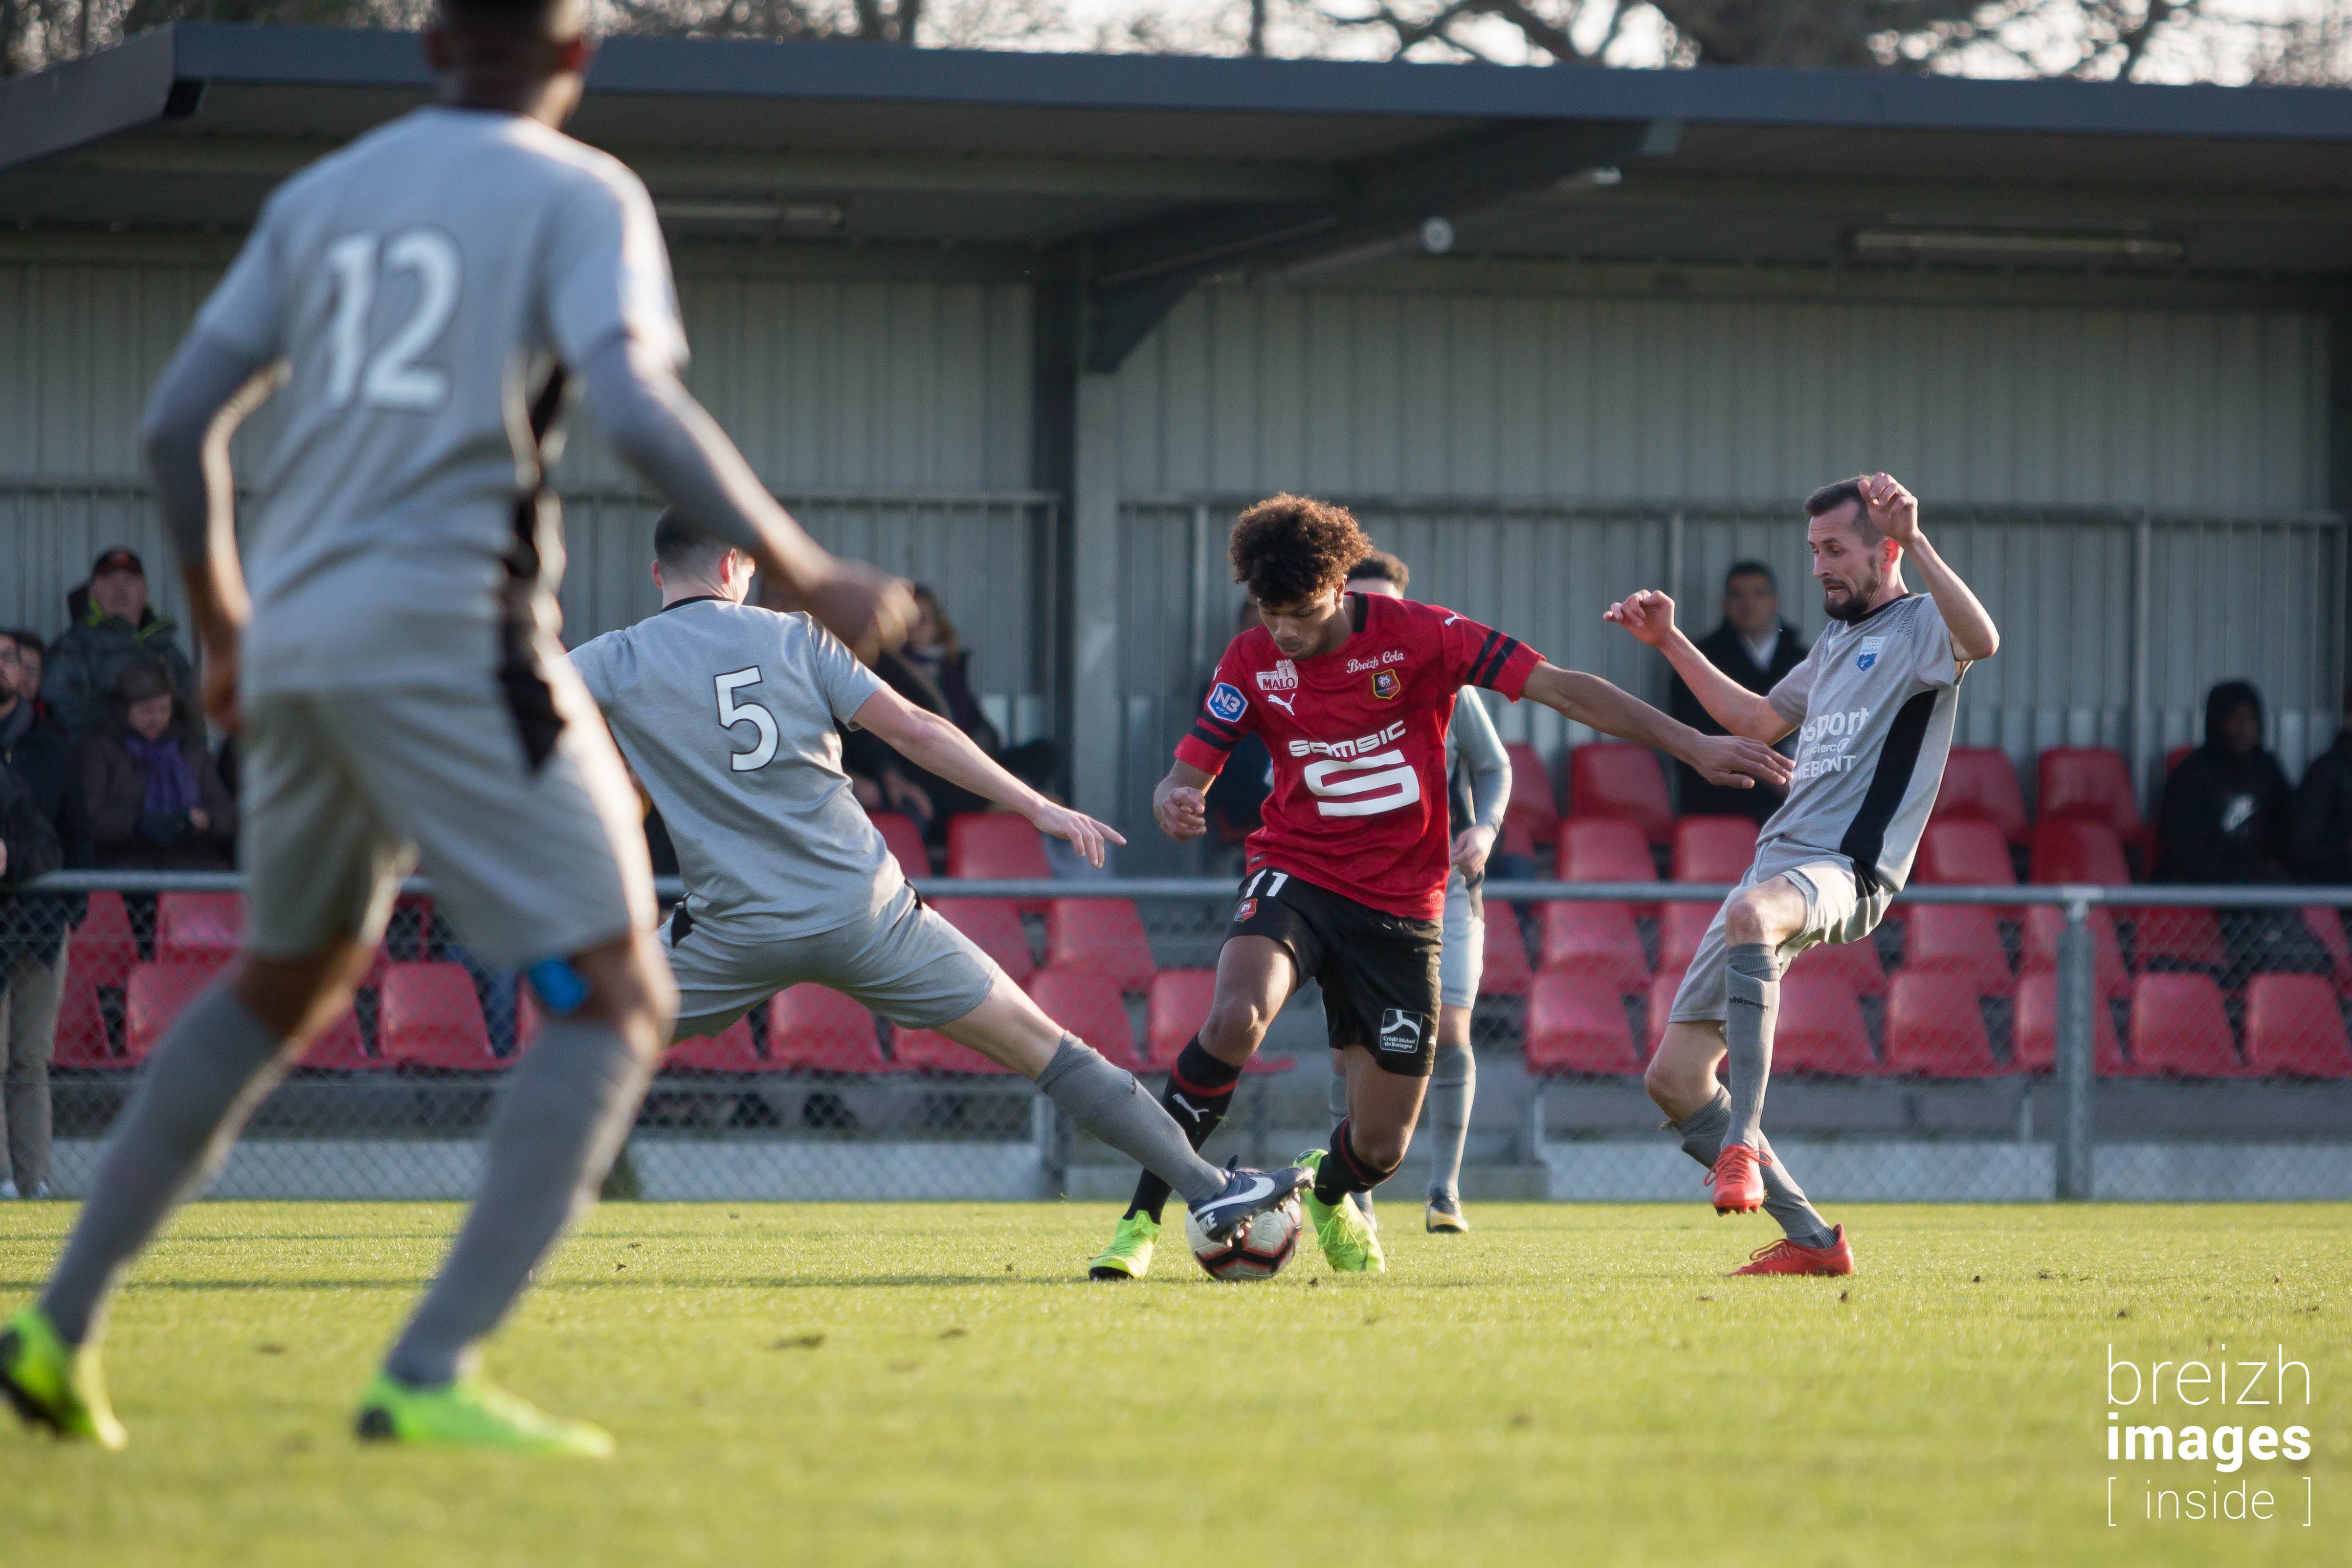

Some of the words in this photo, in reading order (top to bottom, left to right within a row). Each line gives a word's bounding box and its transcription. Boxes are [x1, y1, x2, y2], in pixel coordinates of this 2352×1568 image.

[327, 232, 459, 405] 12
[1346, 656, 1379, 673] Breizh
[1383, 650, 1404, 663] Cola
[1262, 677, 1296, 689] MALO
[1215, 687, 1241, 712] N3
[713, 665, 780, 773] 5
